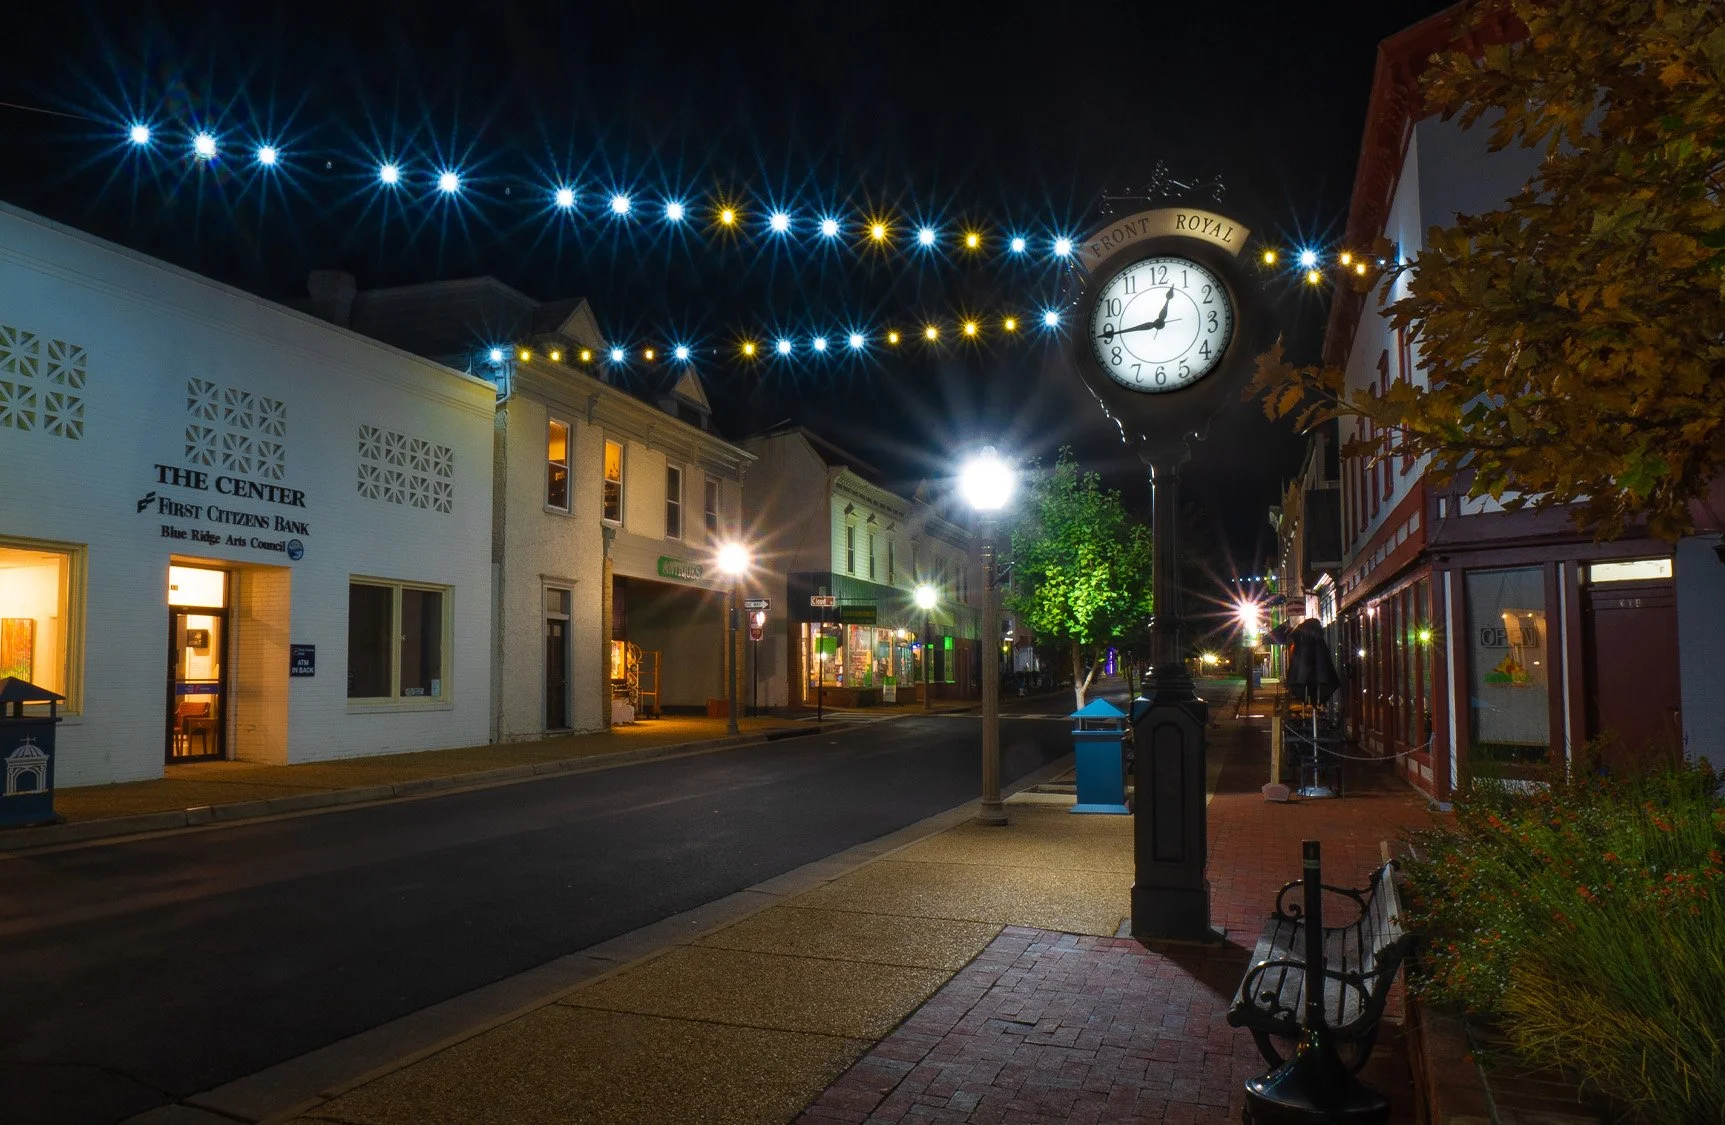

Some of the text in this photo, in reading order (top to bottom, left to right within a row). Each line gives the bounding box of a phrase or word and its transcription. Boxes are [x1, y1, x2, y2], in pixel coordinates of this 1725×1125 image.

[1090, 213, 1234, 258] FRONT ROYAL
[1123, 275, 1137, 295] 11
[1150, 265, 1169, 286] 12
[1181, 269, 1189, 289] 1
[1201, 284, 1214, 305] 2
[1105, 297, 1122, 318] 10
[1207, 310, 1219, 333] 3
[1102, 323, 1115, 345] 9
[1111, 346, 1123, 366] 8
[1199, 339, 1212, 361] 4
[1129, 363, 1144, 384] 7
[1155, 366, 1167, 385] 6
[1178, 357, 1190, 379] 5
[154, 464, 307, 509] THE CENTER
[161, 525, 286, 552] Blue Ridge Arts Council
[1482, 627, 1534, 645] OPEN
